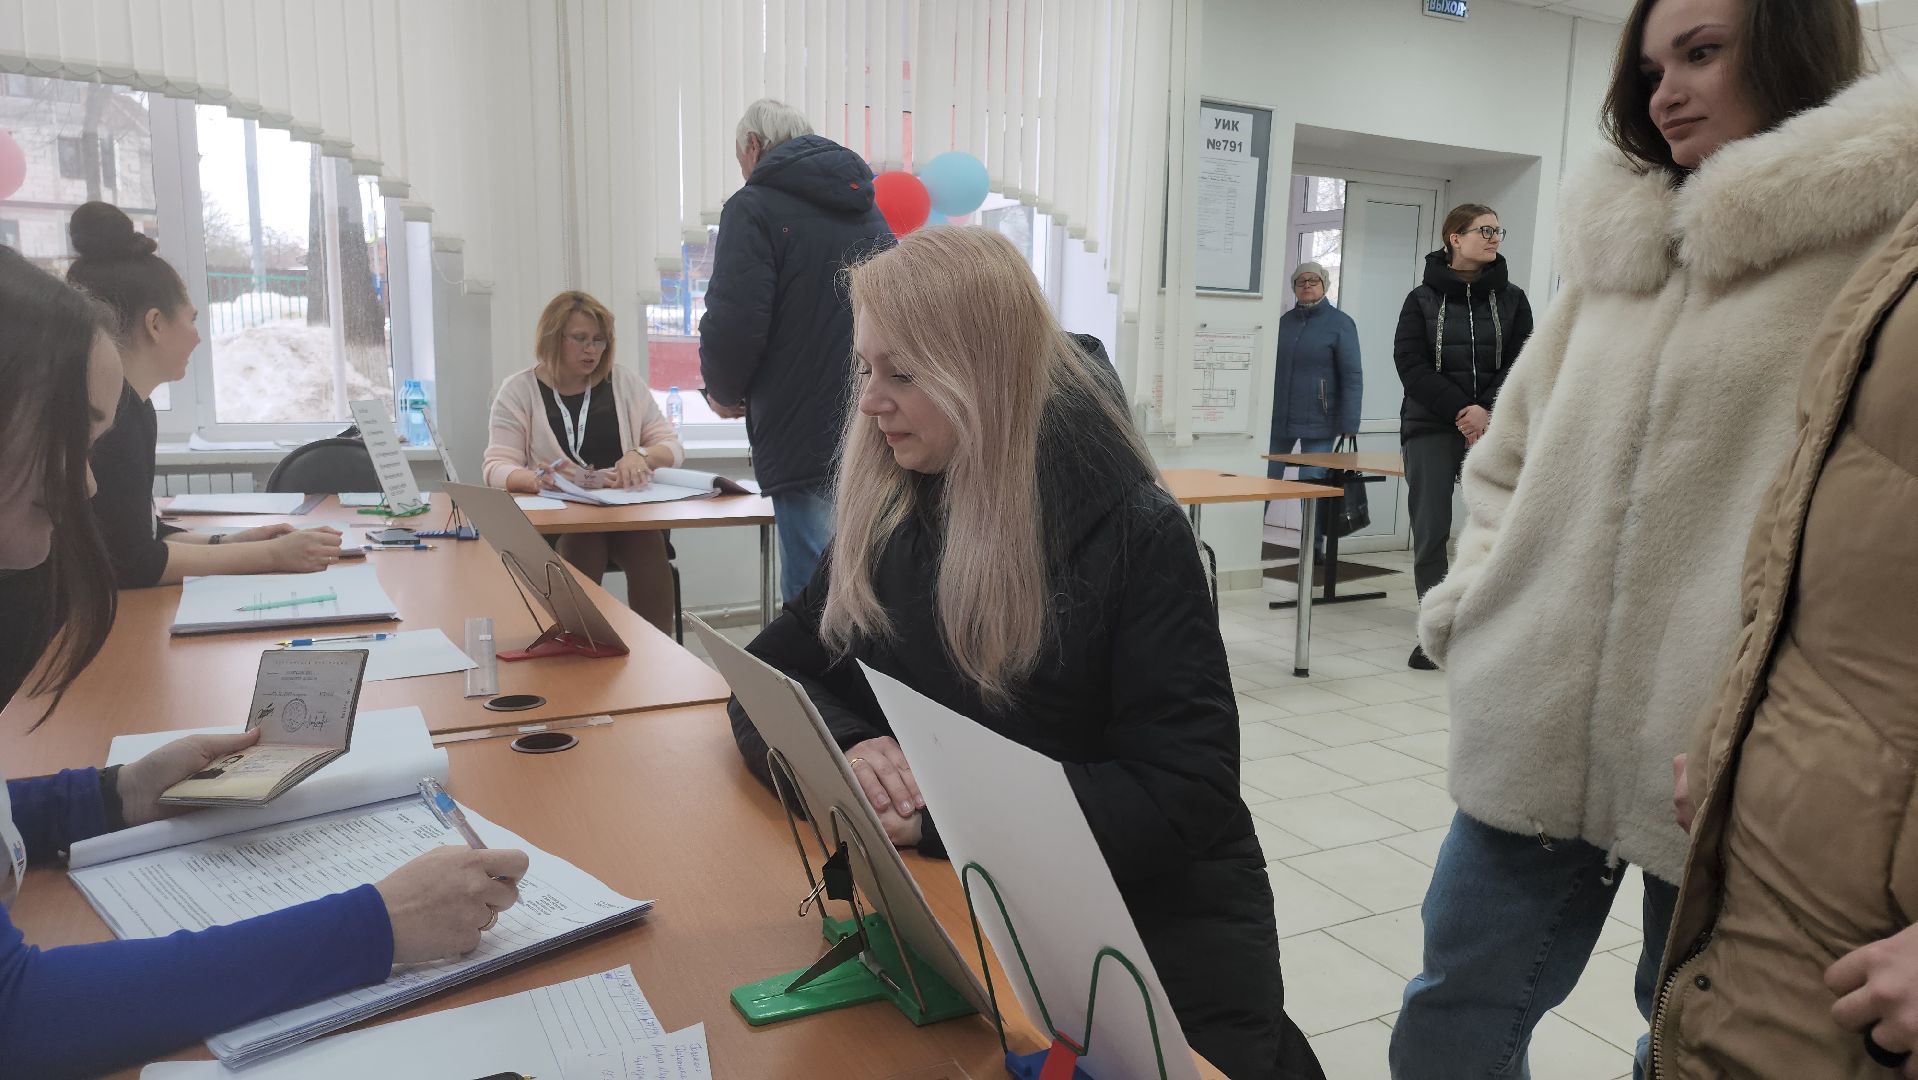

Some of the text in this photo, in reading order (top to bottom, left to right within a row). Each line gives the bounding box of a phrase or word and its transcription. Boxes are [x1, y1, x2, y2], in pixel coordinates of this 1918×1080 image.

[1429, 0, 1466, 16] ВЫХОД
[1214, 117, 1239, 132] УИК
[1206, 138, 1242, 153] №791
